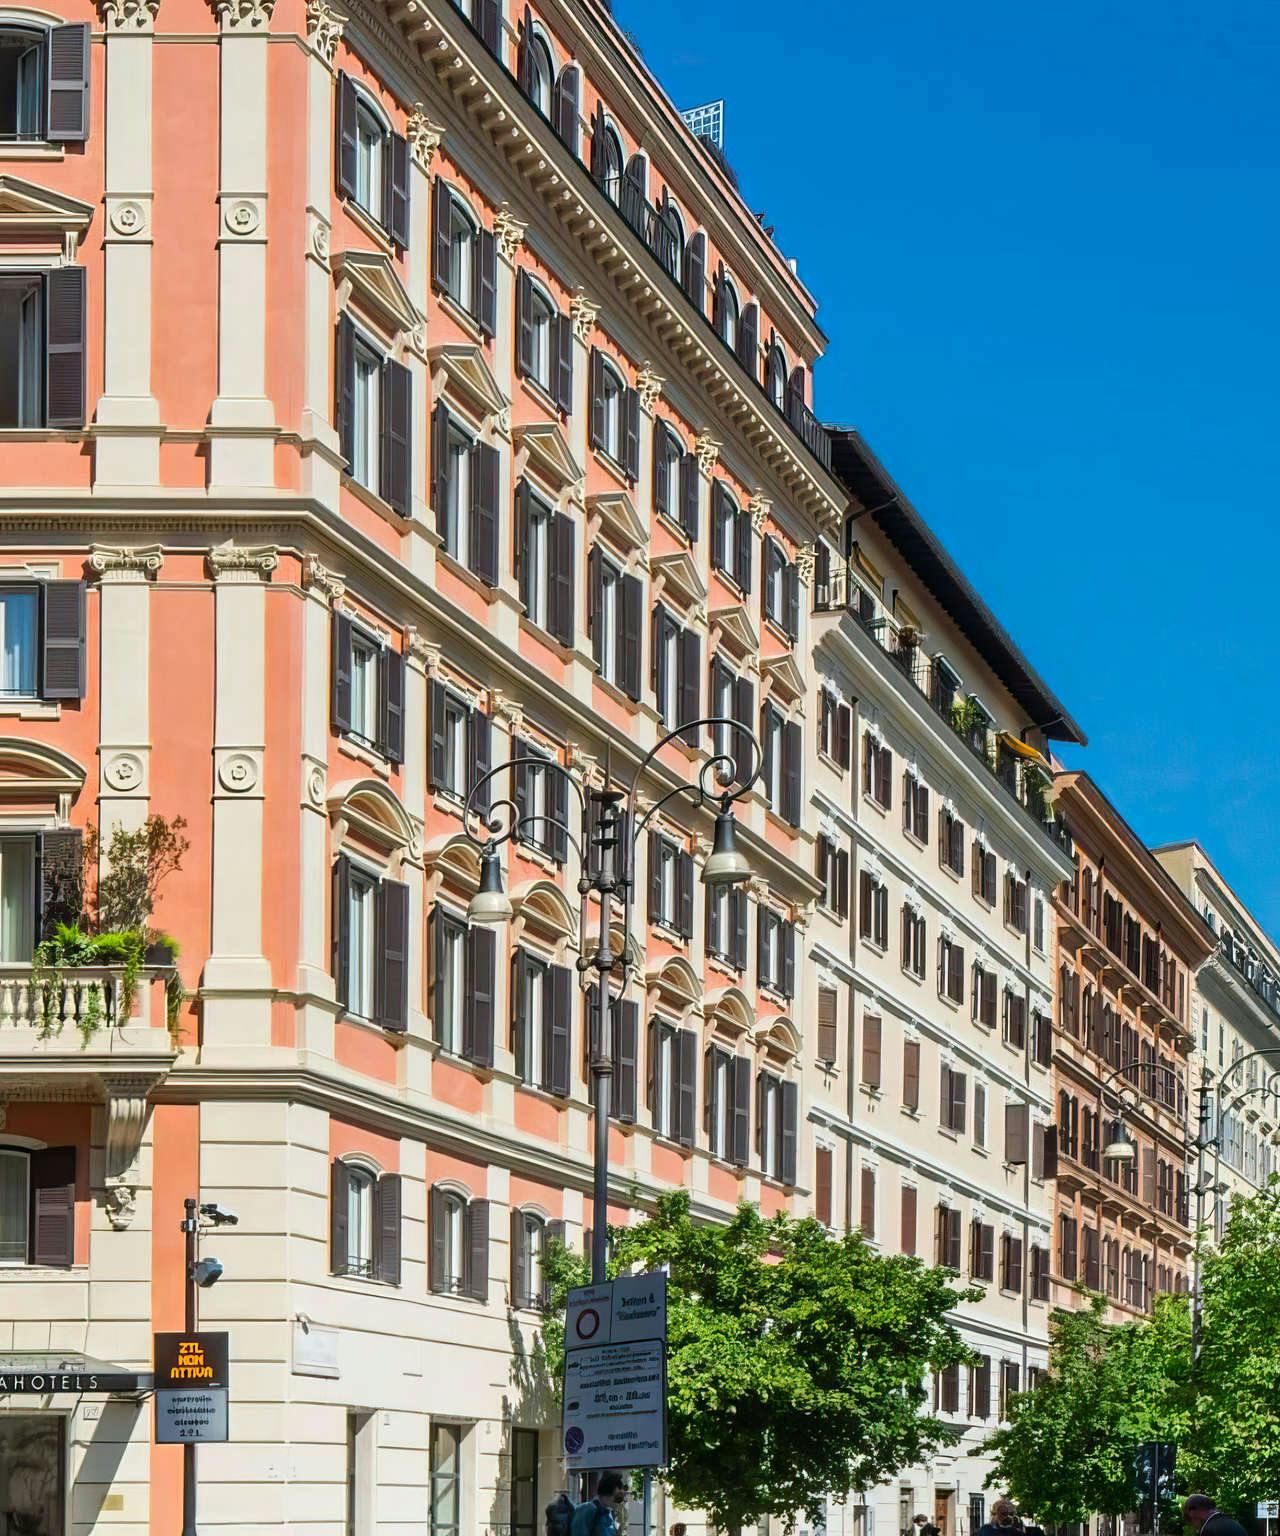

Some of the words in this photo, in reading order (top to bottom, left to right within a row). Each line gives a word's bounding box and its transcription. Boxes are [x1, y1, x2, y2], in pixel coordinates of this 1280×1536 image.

[178, 1342, 205, 1354] ZTL
[178, 1354, 205, 1366] NON
[170, 1366, 213, 1379] ATTIVA
